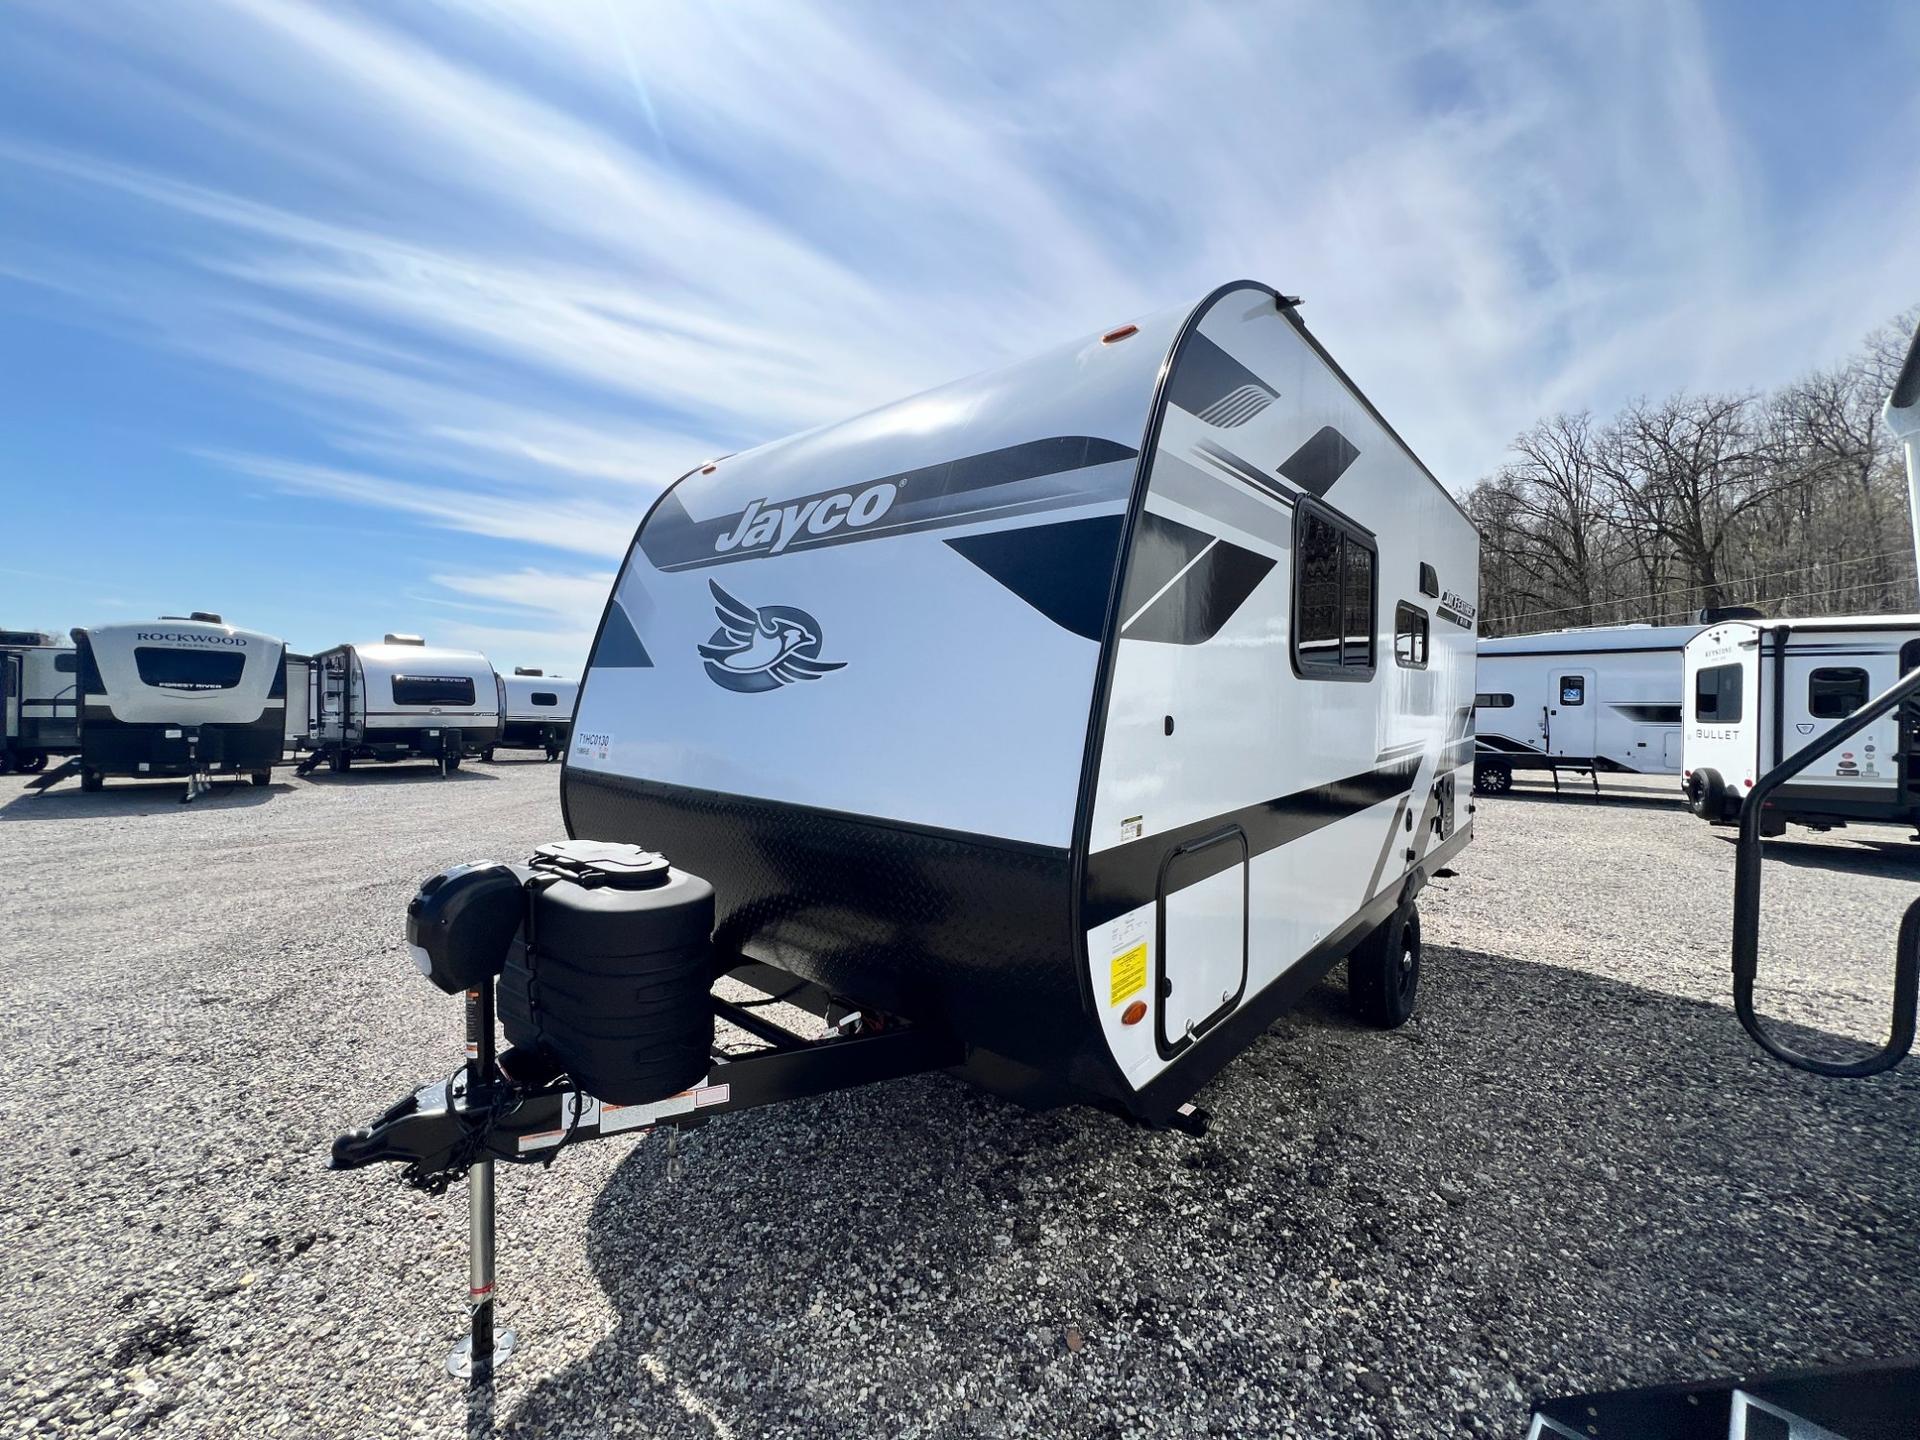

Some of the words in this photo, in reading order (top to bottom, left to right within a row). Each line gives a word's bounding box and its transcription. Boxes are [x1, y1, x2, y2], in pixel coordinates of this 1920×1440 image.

[715, 484, 897, 553] Jayco
[137, 633, 247, 647] ROCKWOOD
[1696, 729, 1740, 740] BULLET
